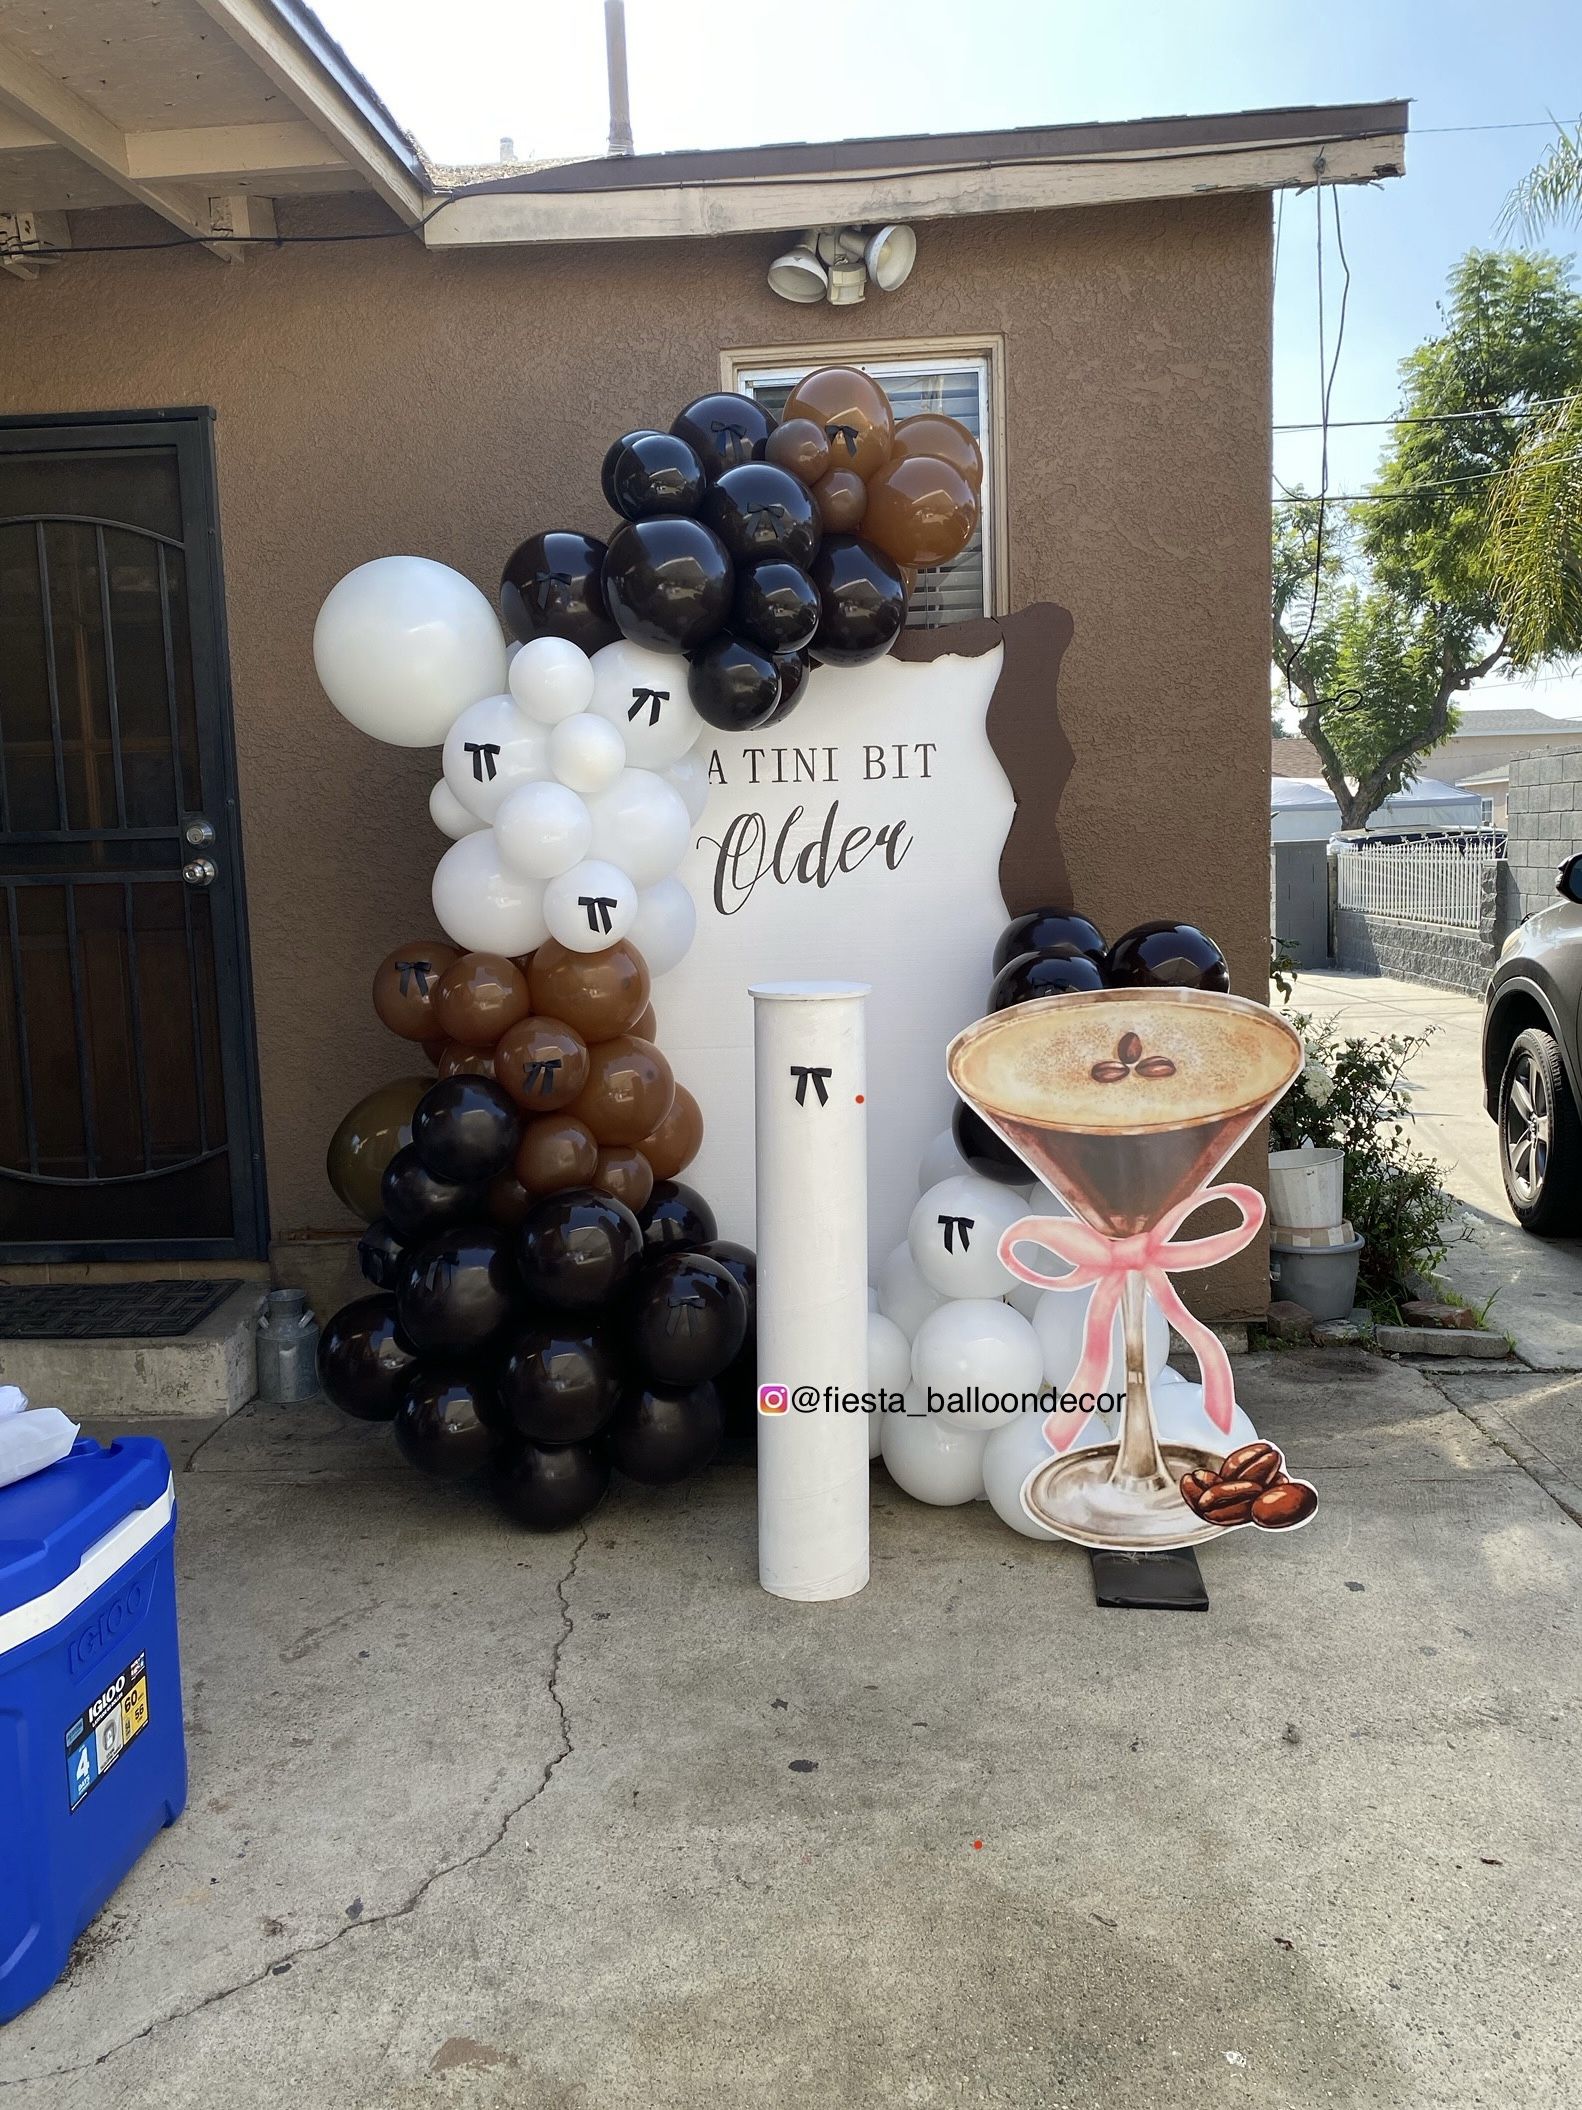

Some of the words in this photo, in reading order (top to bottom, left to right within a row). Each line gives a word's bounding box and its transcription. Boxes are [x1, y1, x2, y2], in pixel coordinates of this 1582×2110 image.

[708, 749, 728, 785] A
[742, 747, 839, 784] TINI
[862, 743, 937, 780] BIT
[696, 800, 914, 916] Older
[67, 1580, 141, 1675] IGLOO
[88, 1674, 125, 1724] IGLOO
[124, 1689, 138, 1714] 60
[76, 1746, 90, 1781] 4
